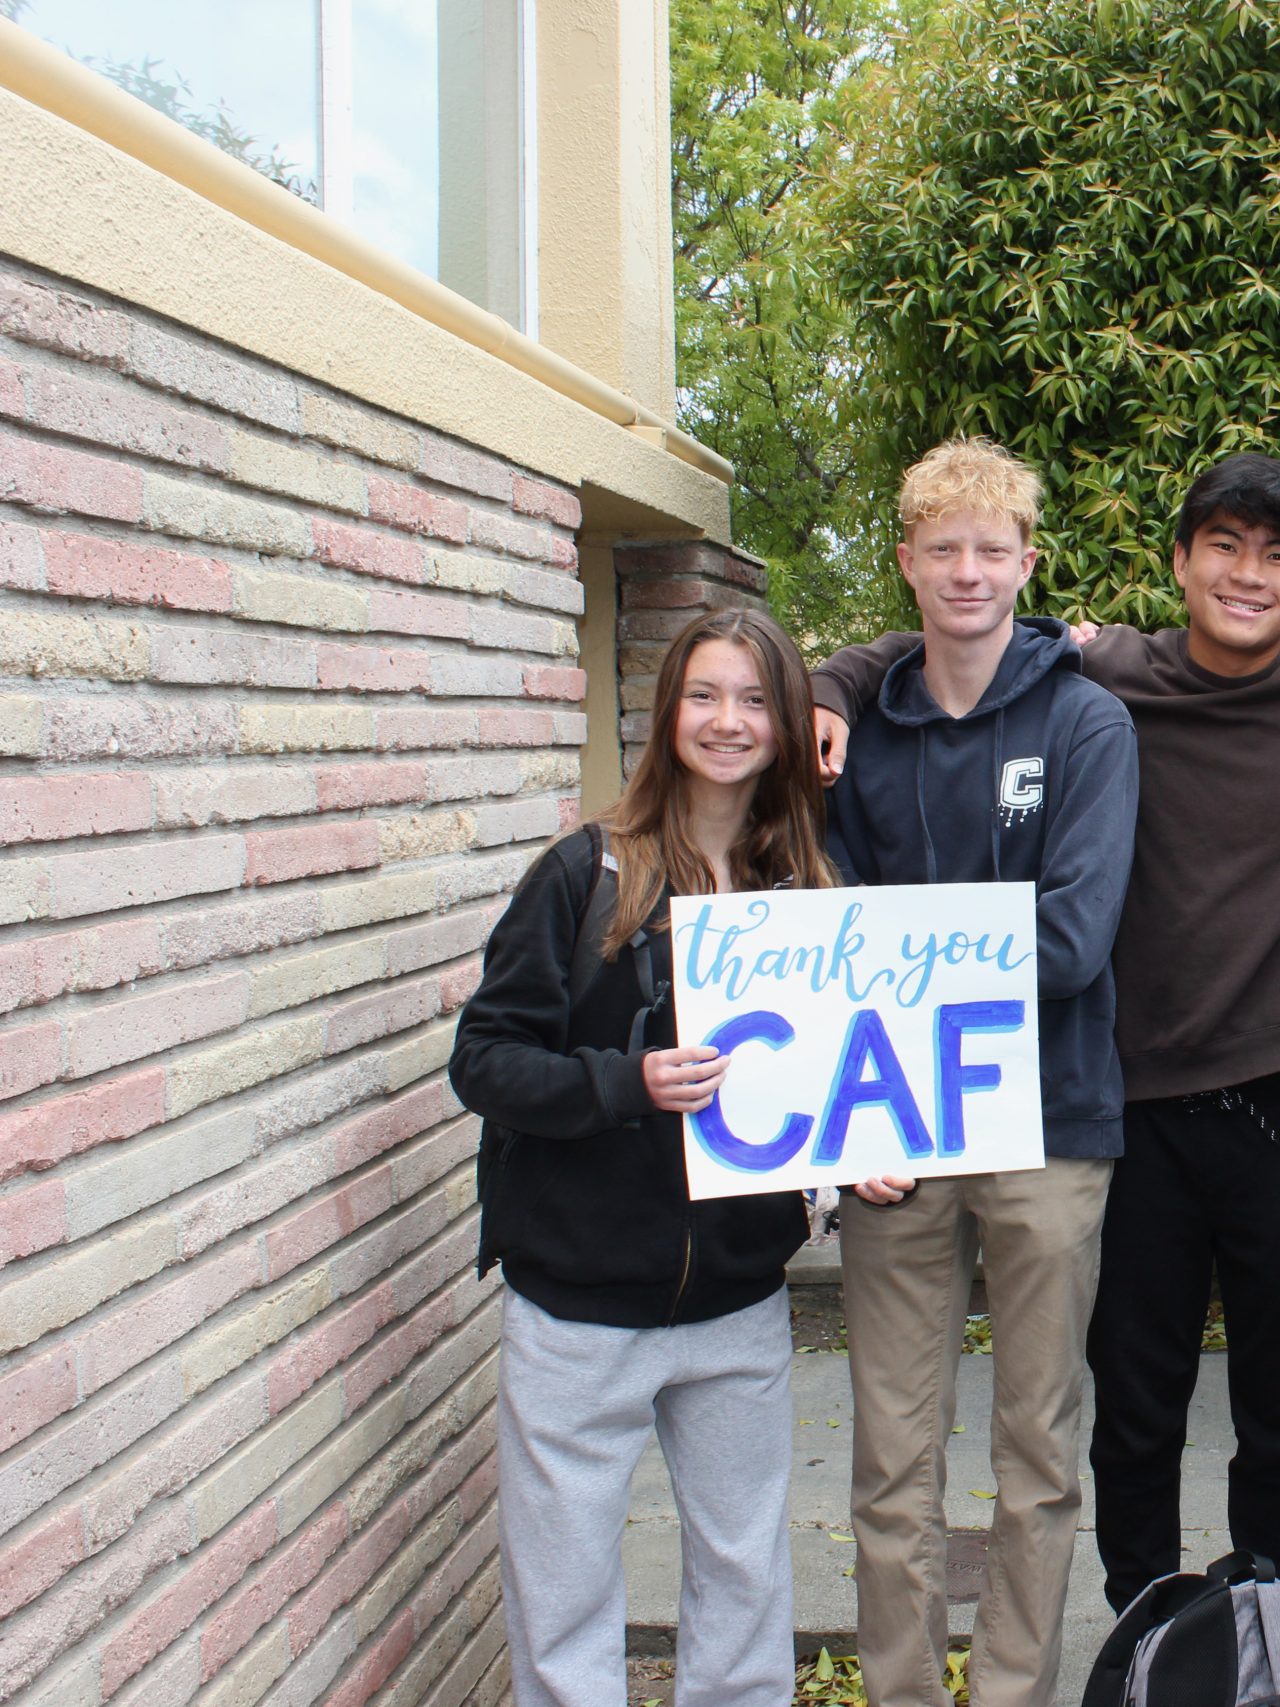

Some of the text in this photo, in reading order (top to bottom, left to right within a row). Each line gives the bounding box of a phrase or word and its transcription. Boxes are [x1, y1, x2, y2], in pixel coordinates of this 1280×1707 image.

[1000, 757, 1044, 809] C
[675, 900, 1037, 1008] thank you
[687, 999, 1026, 1174] CAF
